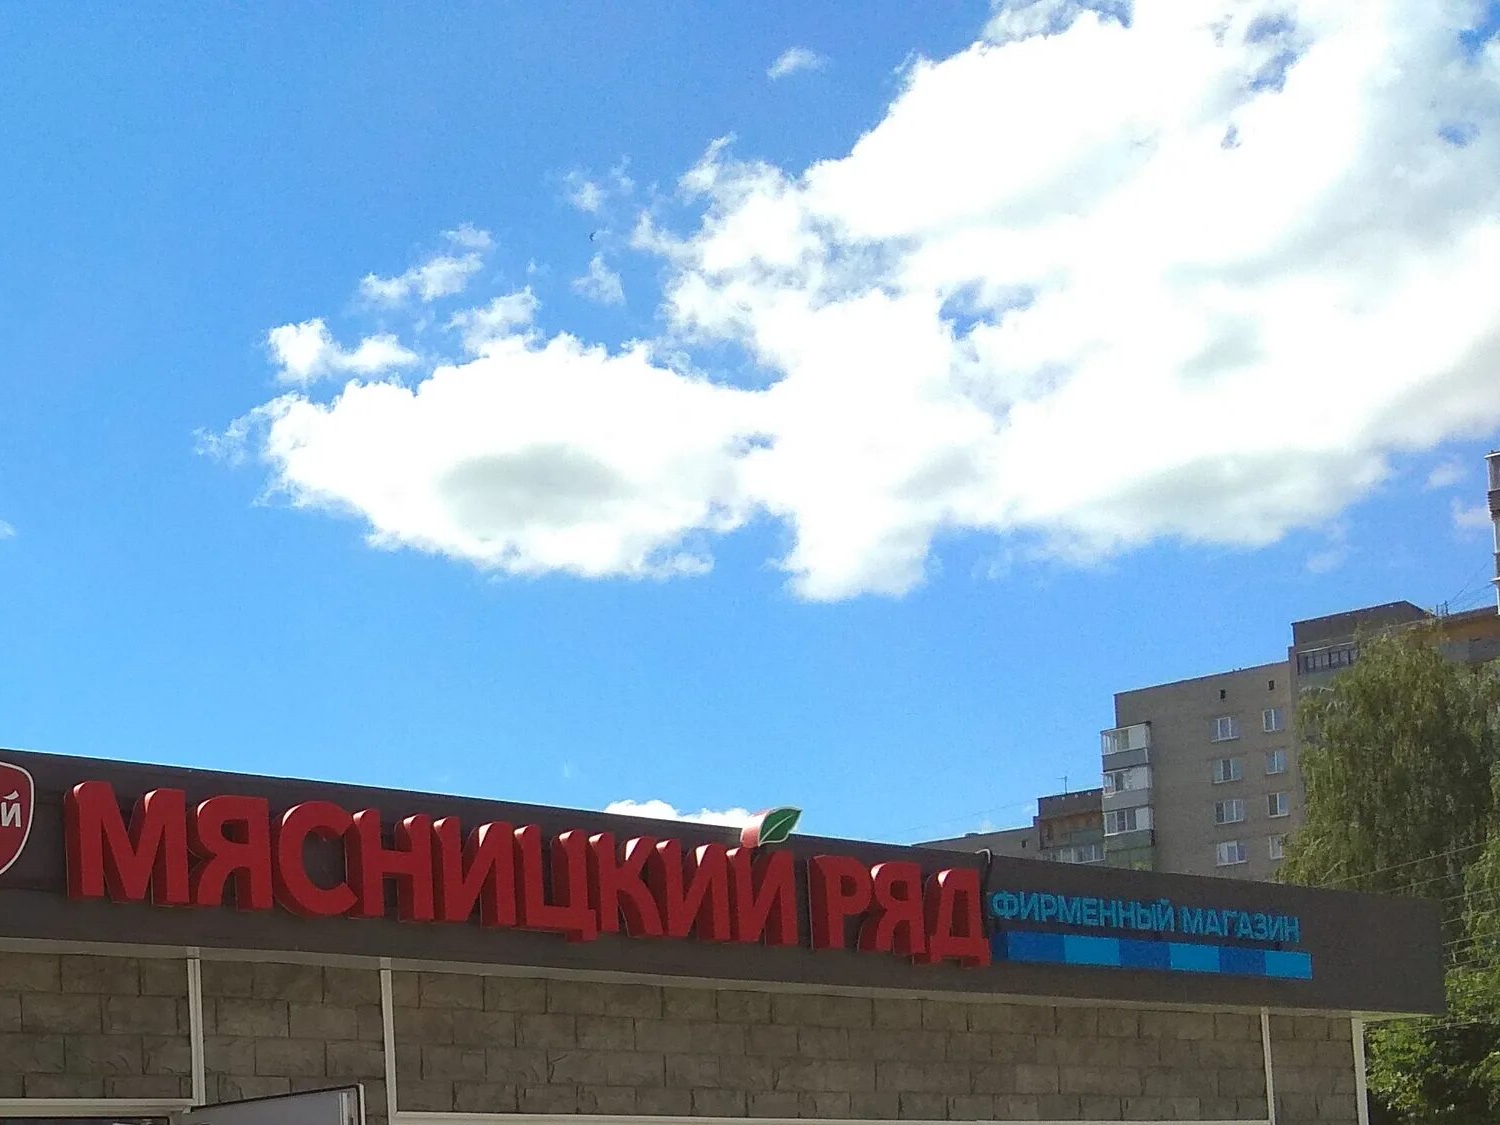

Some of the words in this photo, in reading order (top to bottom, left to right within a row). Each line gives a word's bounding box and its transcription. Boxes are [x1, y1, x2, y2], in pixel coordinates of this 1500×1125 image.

[65, 780, 800, 947] МЯСНИЦКИЙ
[808, 854, 990, 969] РЯД
[990, 890, 1175, 932] ФИРМЕННЫЙ
[1181, 906, 1300, 943] МАГАЗИН
